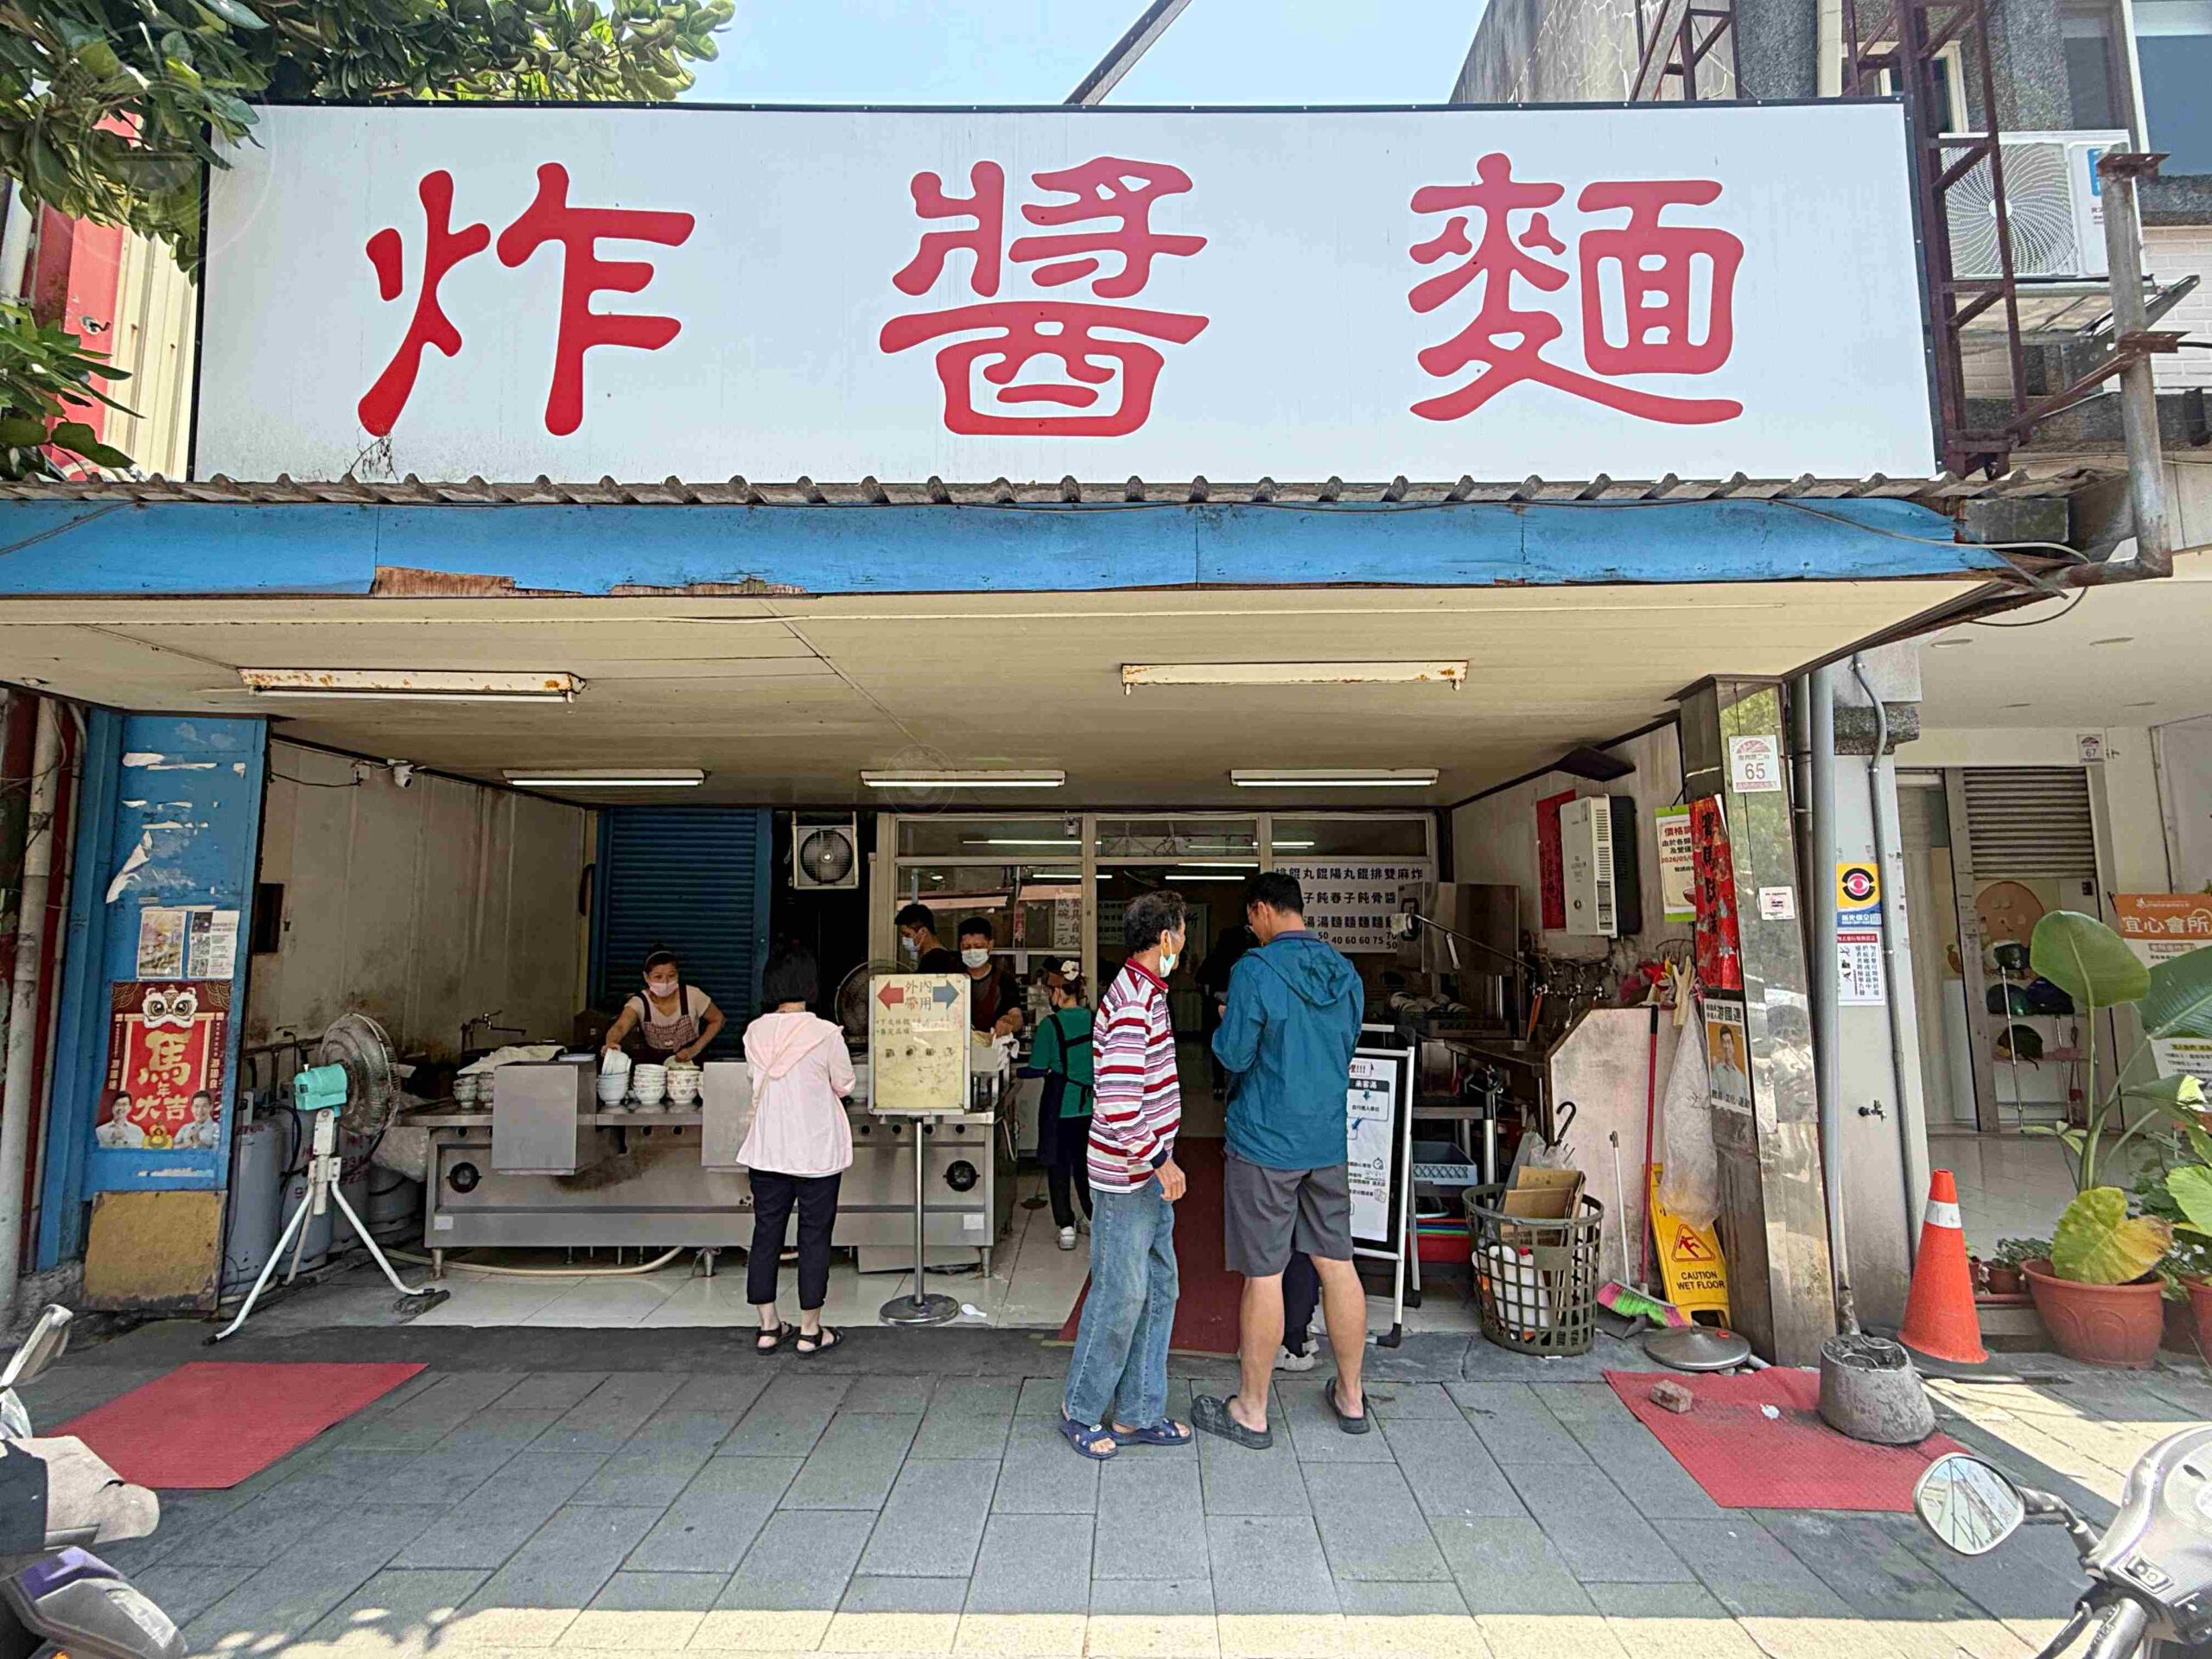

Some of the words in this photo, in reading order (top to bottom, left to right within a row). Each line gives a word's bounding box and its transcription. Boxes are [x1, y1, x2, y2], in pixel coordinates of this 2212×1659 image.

[358, 152, 1744, 437] 炸醬麵
[2085, 747, 2096, 757] 67
[1745, 762, 1766, 779] 65
[2121, 916, 2209, 933] 宜心會所
[131, 1095, 188, 1122] 大吉
[1681, 1271, 1718, 1281] CAUTION
[1676, 1281, 1694, 1290] WET
[1697, 1280, 1726, 1289] FLOOR
